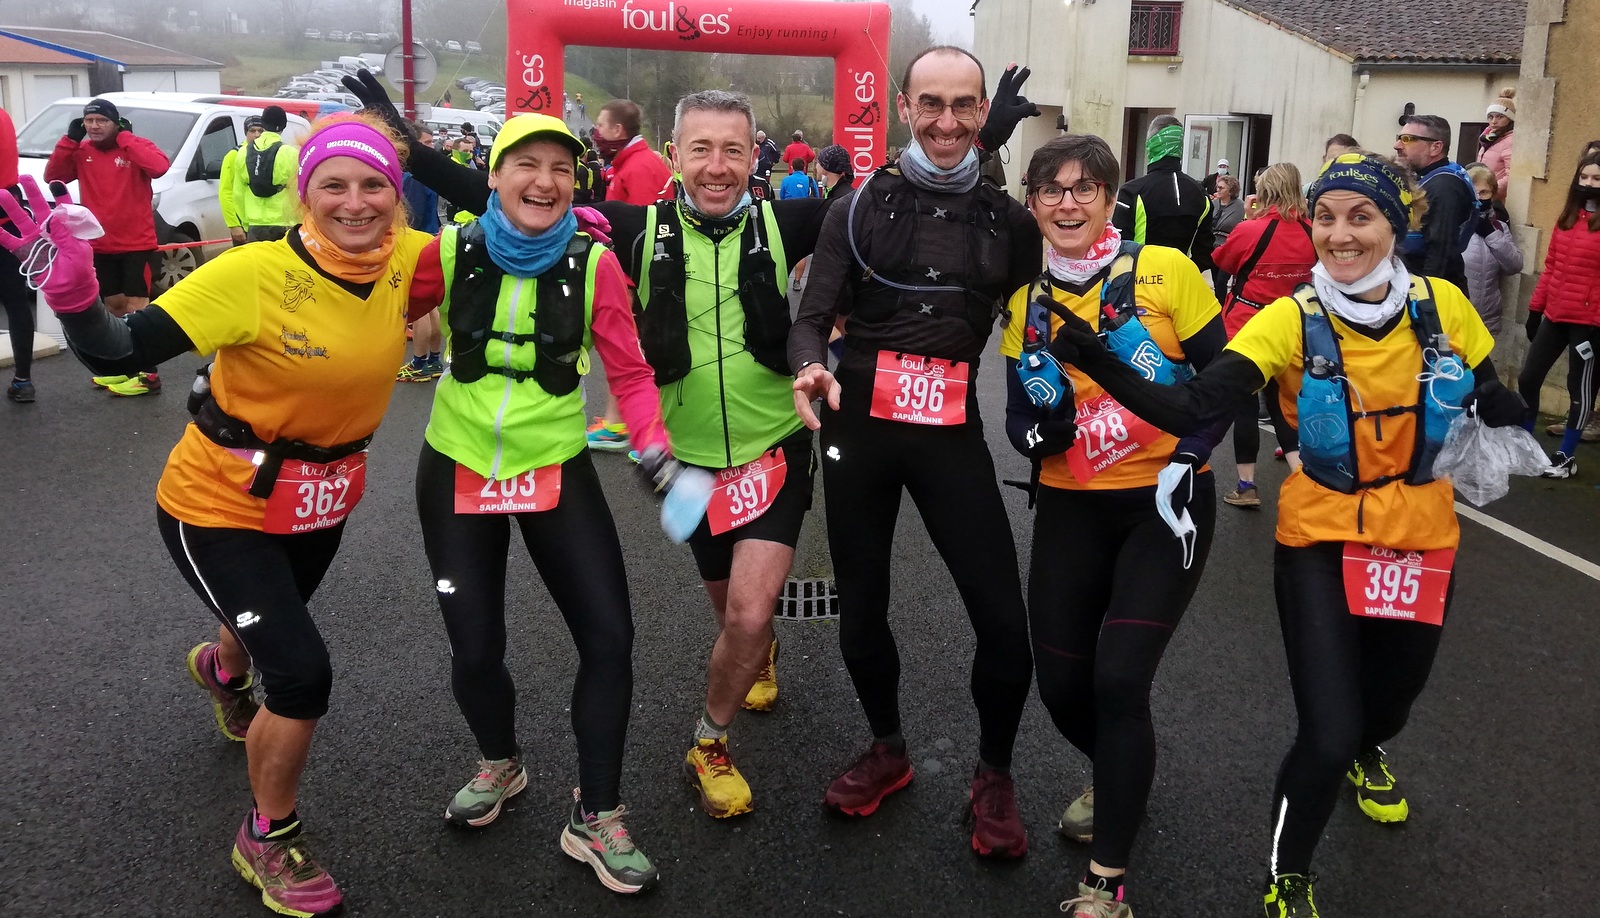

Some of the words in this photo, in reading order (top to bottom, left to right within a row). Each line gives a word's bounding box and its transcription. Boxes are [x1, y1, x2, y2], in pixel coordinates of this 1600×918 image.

[563, 0, 616, 9] magasin
[621, 1, 731, 38] foul&es
[737, 25, 773, 40] Enjoy
[777, 28, 828, 41] running
[512, 54, 547, 116] l&es
[895, 374, 945, 413] 396
[892, 412, 944, 424] SAPURIENNE
[913, 410, 923, 418] LA
[1075, 412, 1129, 460] 228
[1093, 442, 1140, 472] SAPURIENNE
[1107, 448, 1121, 459] LA
[295, 477, 350, 518] 362
[726, 472, 768, 515] 397
[479, 502, 536, 512] SAPURIENNE
[502, 499, 514, 508] LA
[317, 516, 327, 524] LA
[1364, 562, 1422, 605] 395
[1364, 606, 1416, 619] SAPURIENNE
